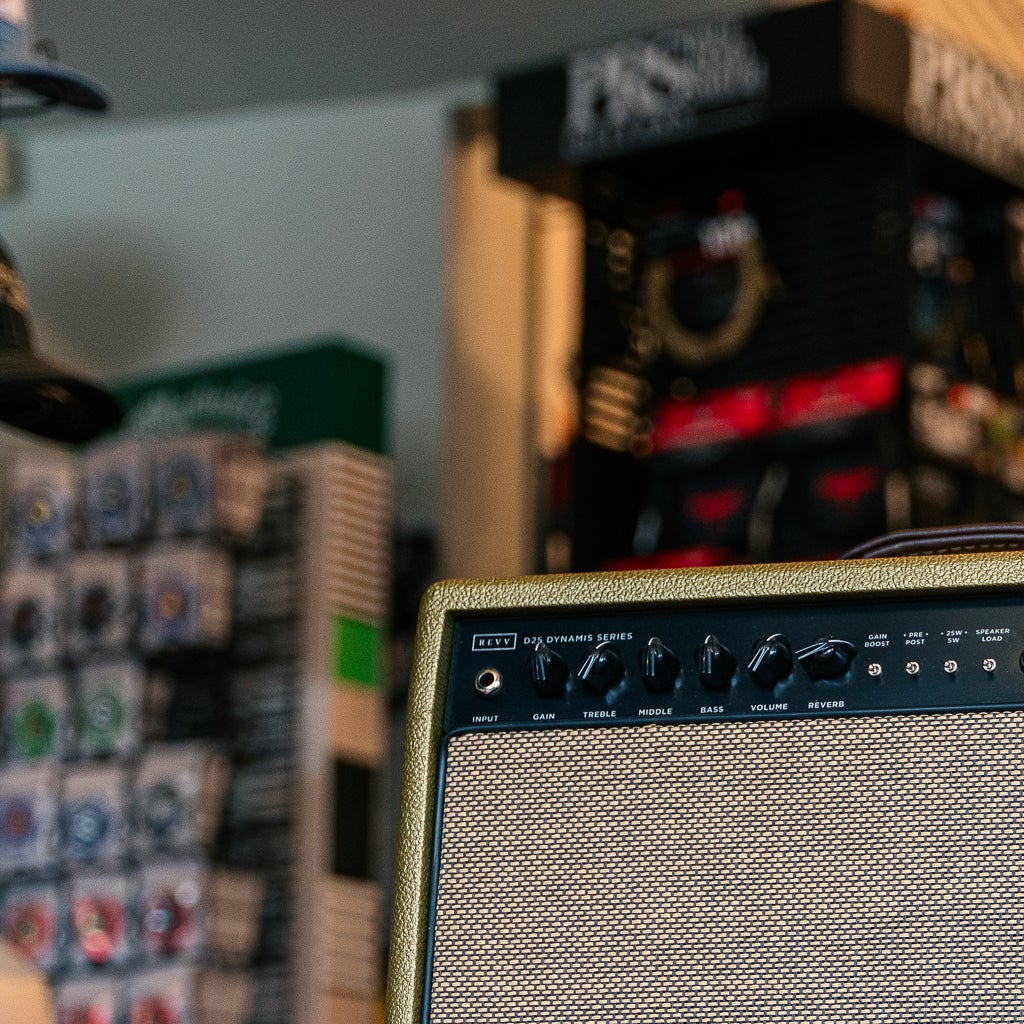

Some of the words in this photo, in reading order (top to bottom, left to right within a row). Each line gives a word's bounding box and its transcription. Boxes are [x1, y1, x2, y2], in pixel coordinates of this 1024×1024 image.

[479, 638, 510, 646] REVV
[523, 636, 543, 644] D25
[546, 634, 593, 644] DYNAMIS
[596, 632, 633, 641] SERIES
[750, 703, 788, 711] VOLUME
[808, 700, 845, 709] REVERB
[583, 710, 616, 718] TREBLE
[638, 708, 673, 716] MIDDLE
[700, 706, 724, 714] BASS
[472, 715, 499, 723] INPUT
